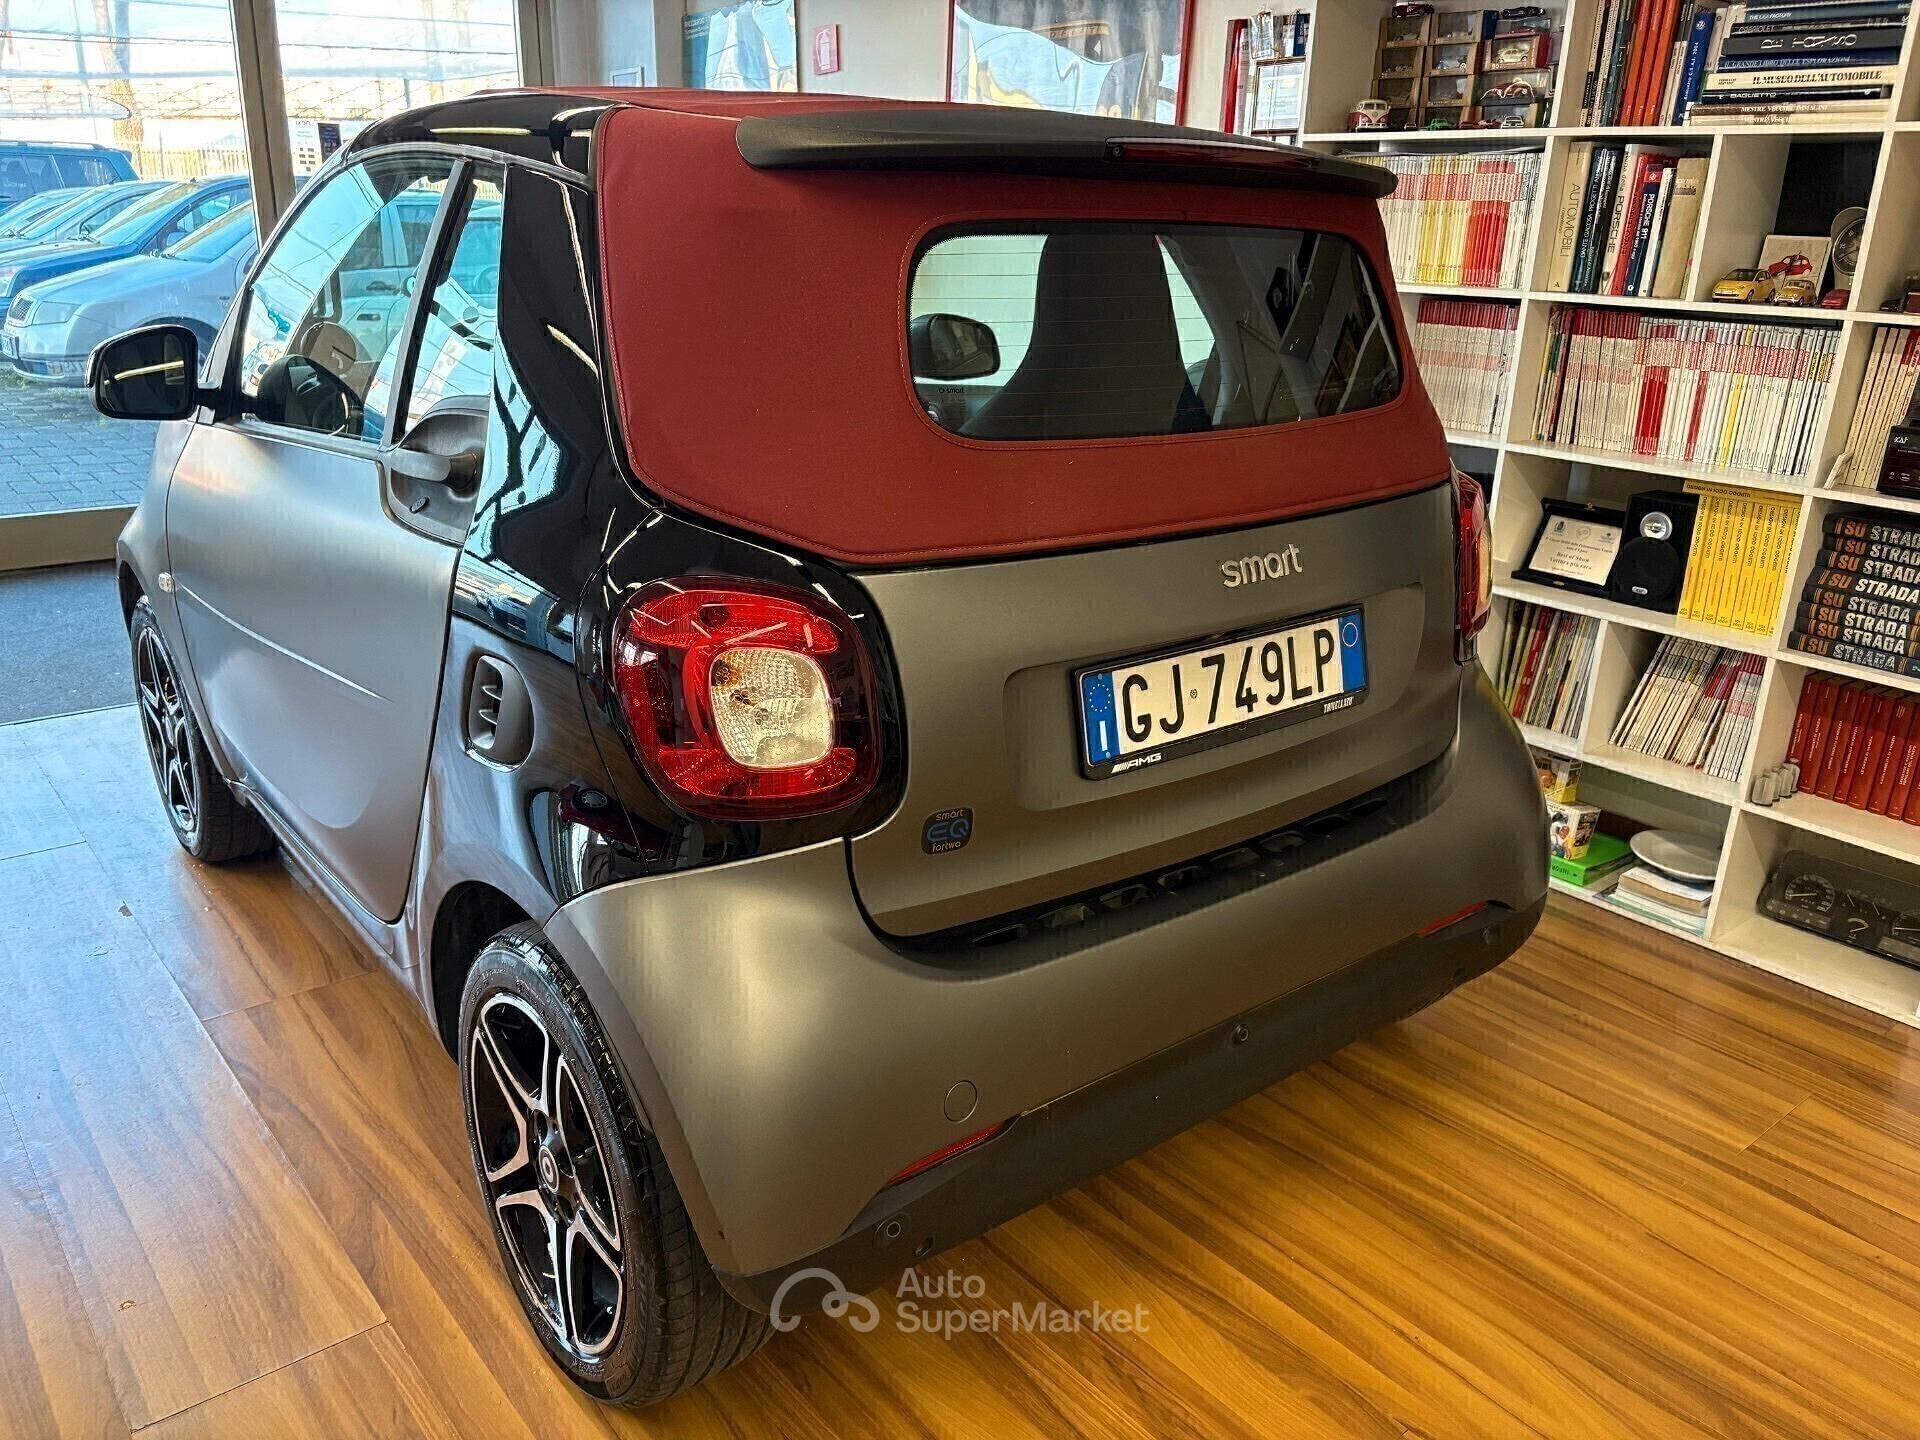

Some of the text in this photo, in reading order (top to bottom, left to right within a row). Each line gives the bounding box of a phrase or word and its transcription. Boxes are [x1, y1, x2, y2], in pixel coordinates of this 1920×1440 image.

[1608, 194, 1625, 254] PORSCHE
[1845, 521, 1867, 538] SU
[1845, 538, 1867, 555] SU
[1221, 543, 1303, 588] smart
[1838, 555, 1860, 572] SU
[1828, 573, 1919, 604] SU STRADA
[1823, 591, 1910, 623] SU STRADA
[1817, 622, 1905, 655] SU STRADA
[1818, 607, 1907, 639] SU STRADA
[1808, 638, 1896, 671] SU STRADA
[1201, 627, 1335, 724] 749LP
[1129, 752, 1162, 768] AMG
[927, 818, 969, 842] EQ
[936, 810, 963, 820] smart
[932, 841, 961, 852] fortwo
